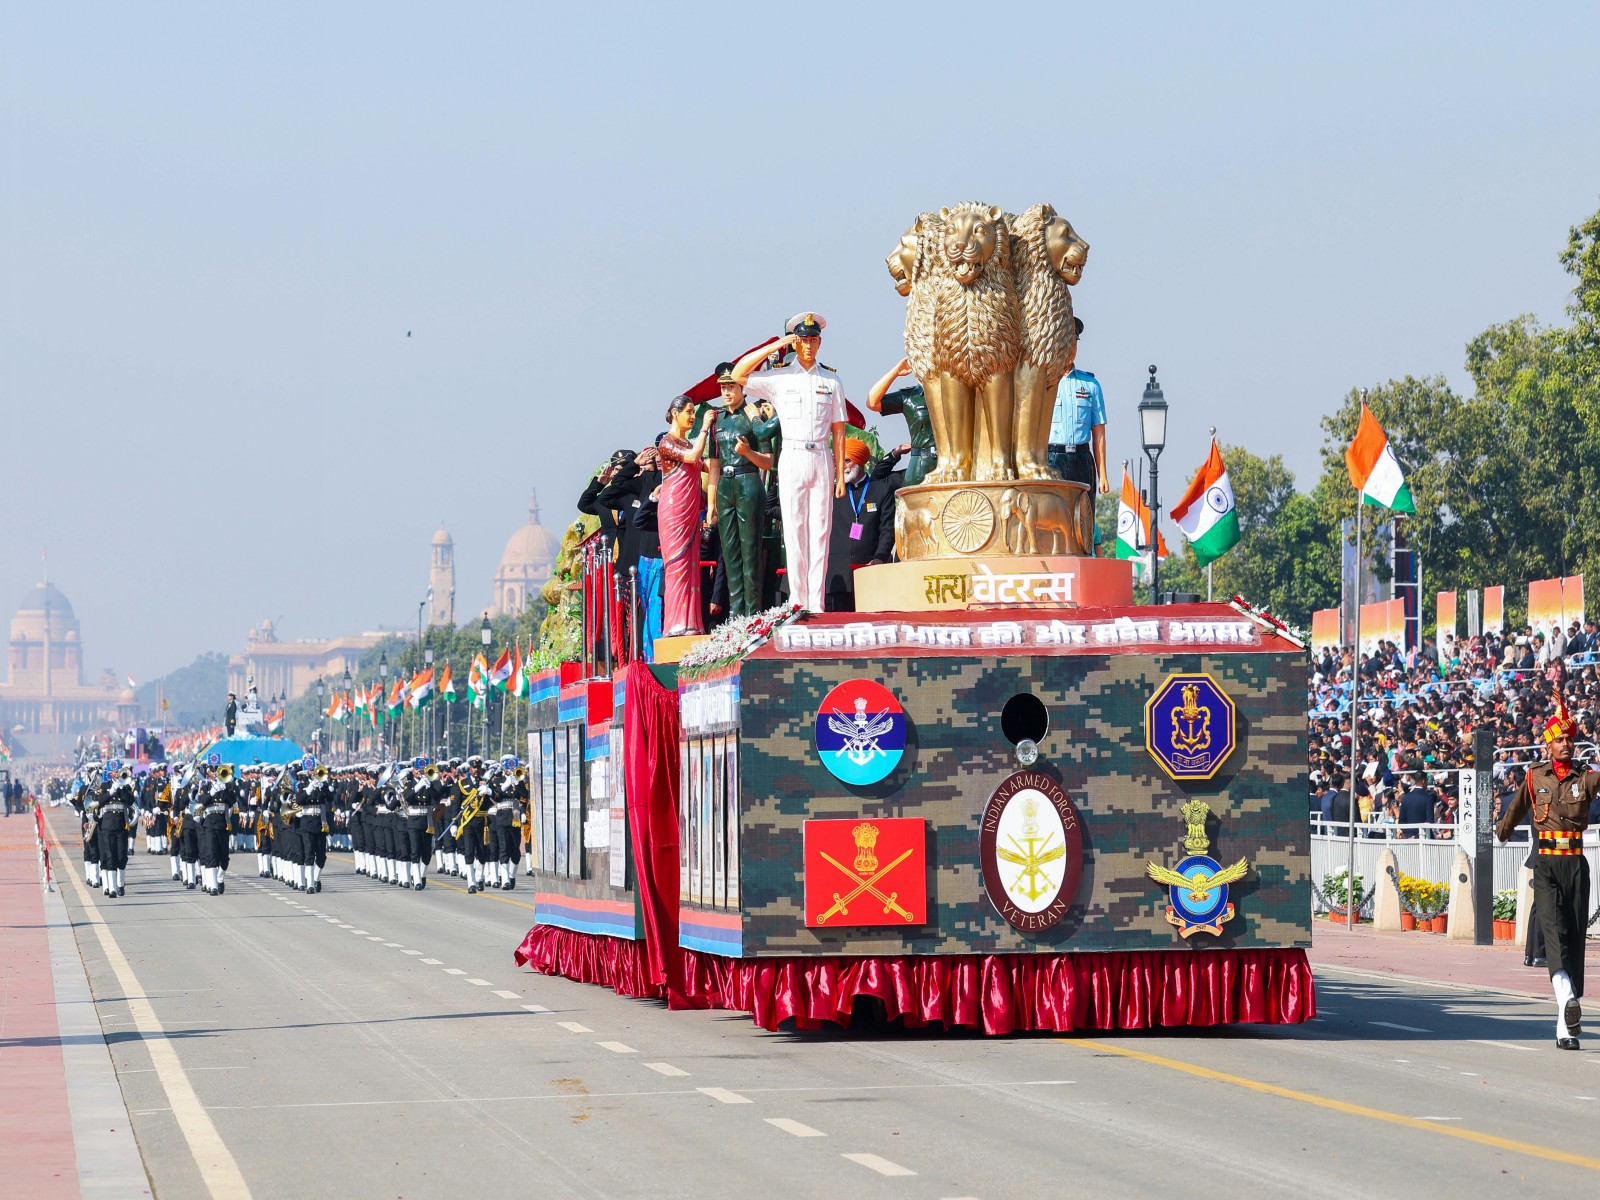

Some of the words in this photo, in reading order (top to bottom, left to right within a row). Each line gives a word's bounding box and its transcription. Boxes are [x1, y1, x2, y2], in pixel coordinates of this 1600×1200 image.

[924, 574, 968, 603] सत्य
[972, 563, 1075, 604] वेटरन्स
[778, 622, 898, 648] विकसित
[901, 624, 972, 646] भारत
[979, 620, 1022, 645] की
[1035, 620, 1086, 645] और
[1092, 617, 1160, 643] सदैव
[1169, 621, 1253, 643] अग्रसर
[984, 787, 1010, 833] INDIAN
[1010, 774, 1051, 793] ARMED
[1048, 785, 1076, 831] FORCES
[1002, 898, 1066, 929] VETERAN
